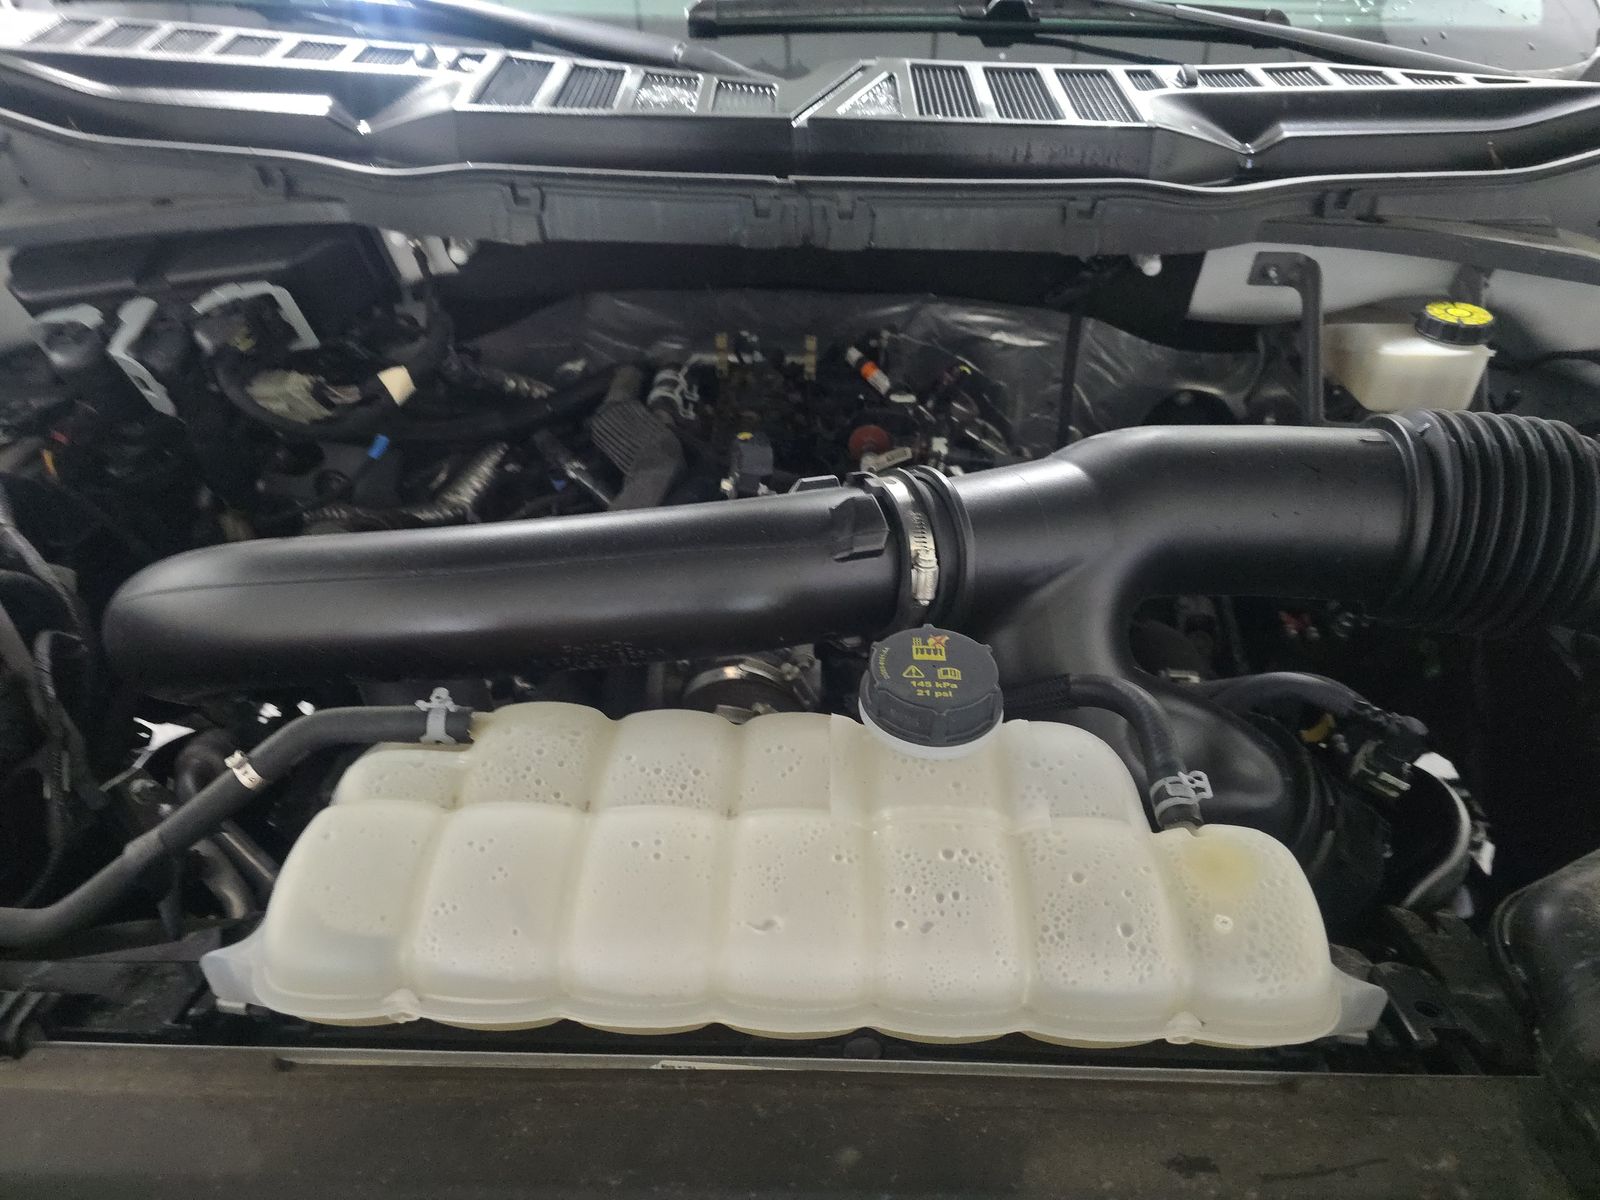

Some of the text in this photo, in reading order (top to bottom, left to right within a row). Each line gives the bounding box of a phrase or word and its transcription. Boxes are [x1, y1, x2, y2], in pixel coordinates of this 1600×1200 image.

[911, 680, 958, 689] 145 kPa
[916, 689, 953, 699] 21 psi
